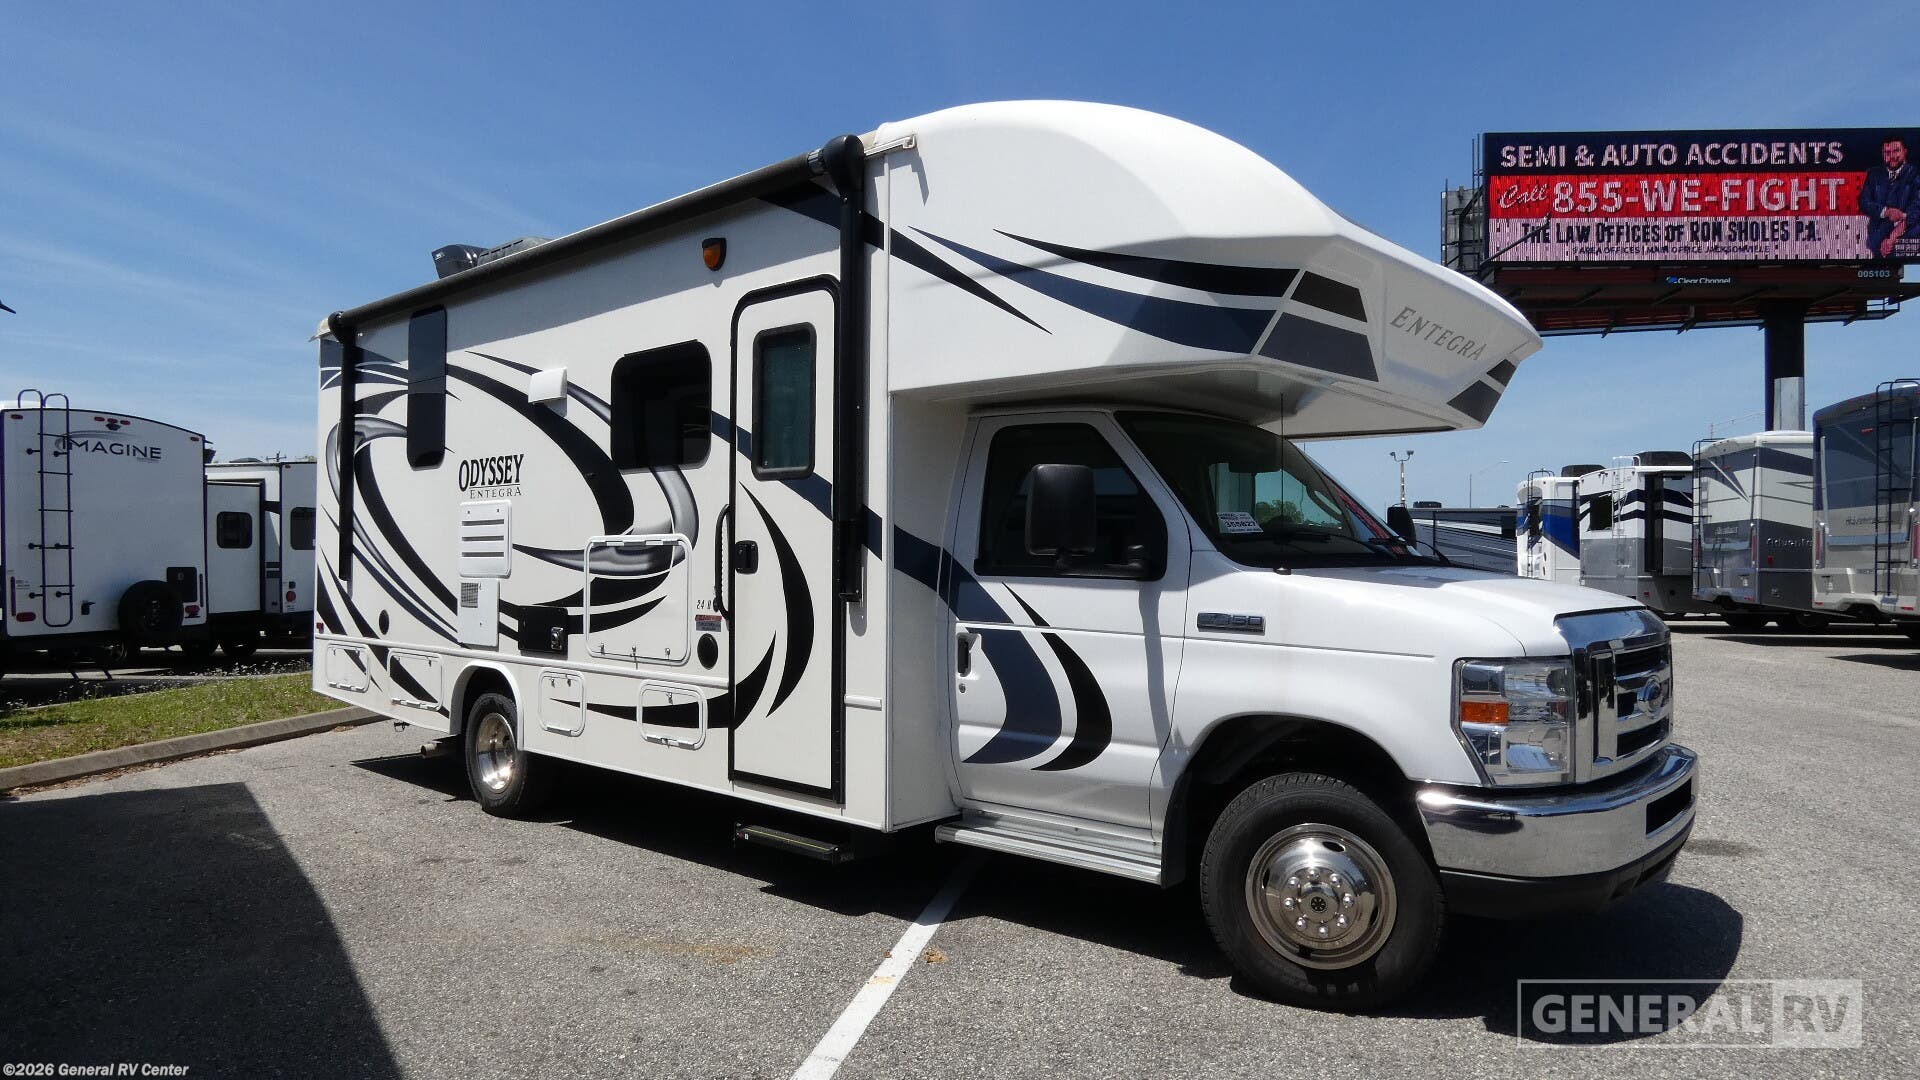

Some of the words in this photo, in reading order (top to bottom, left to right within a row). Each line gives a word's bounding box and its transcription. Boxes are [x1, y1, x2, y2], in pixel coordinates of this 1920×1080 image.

[1500, 145, 1566, 168] SEMI
[1575, 145, 1595, 167] &
[1600, 144, 1678, 166] AUTO
[1685, 142, 1844, 165] ACCIDENTS
[1499, 183, 1548, 209] Call
[1553, 178, 1845, 213] 855-WE-FIGHT
[1556, 222, 1590, 243] LAW
[1596, 221, 1661, 243] OFFICES
[1689, 220, 1721, 242] RON
[1727, 220, 1790, 242] SHOLES
[1857, 269, 1891, 278] 005103
[1390, 306, 1488, 361] ENTEGRA
[62, 436, 161, 459] IMAGINE
[459, 453, 524, 492] ODYSSEY
[470, 486, 522, 499] ENTEGRA
